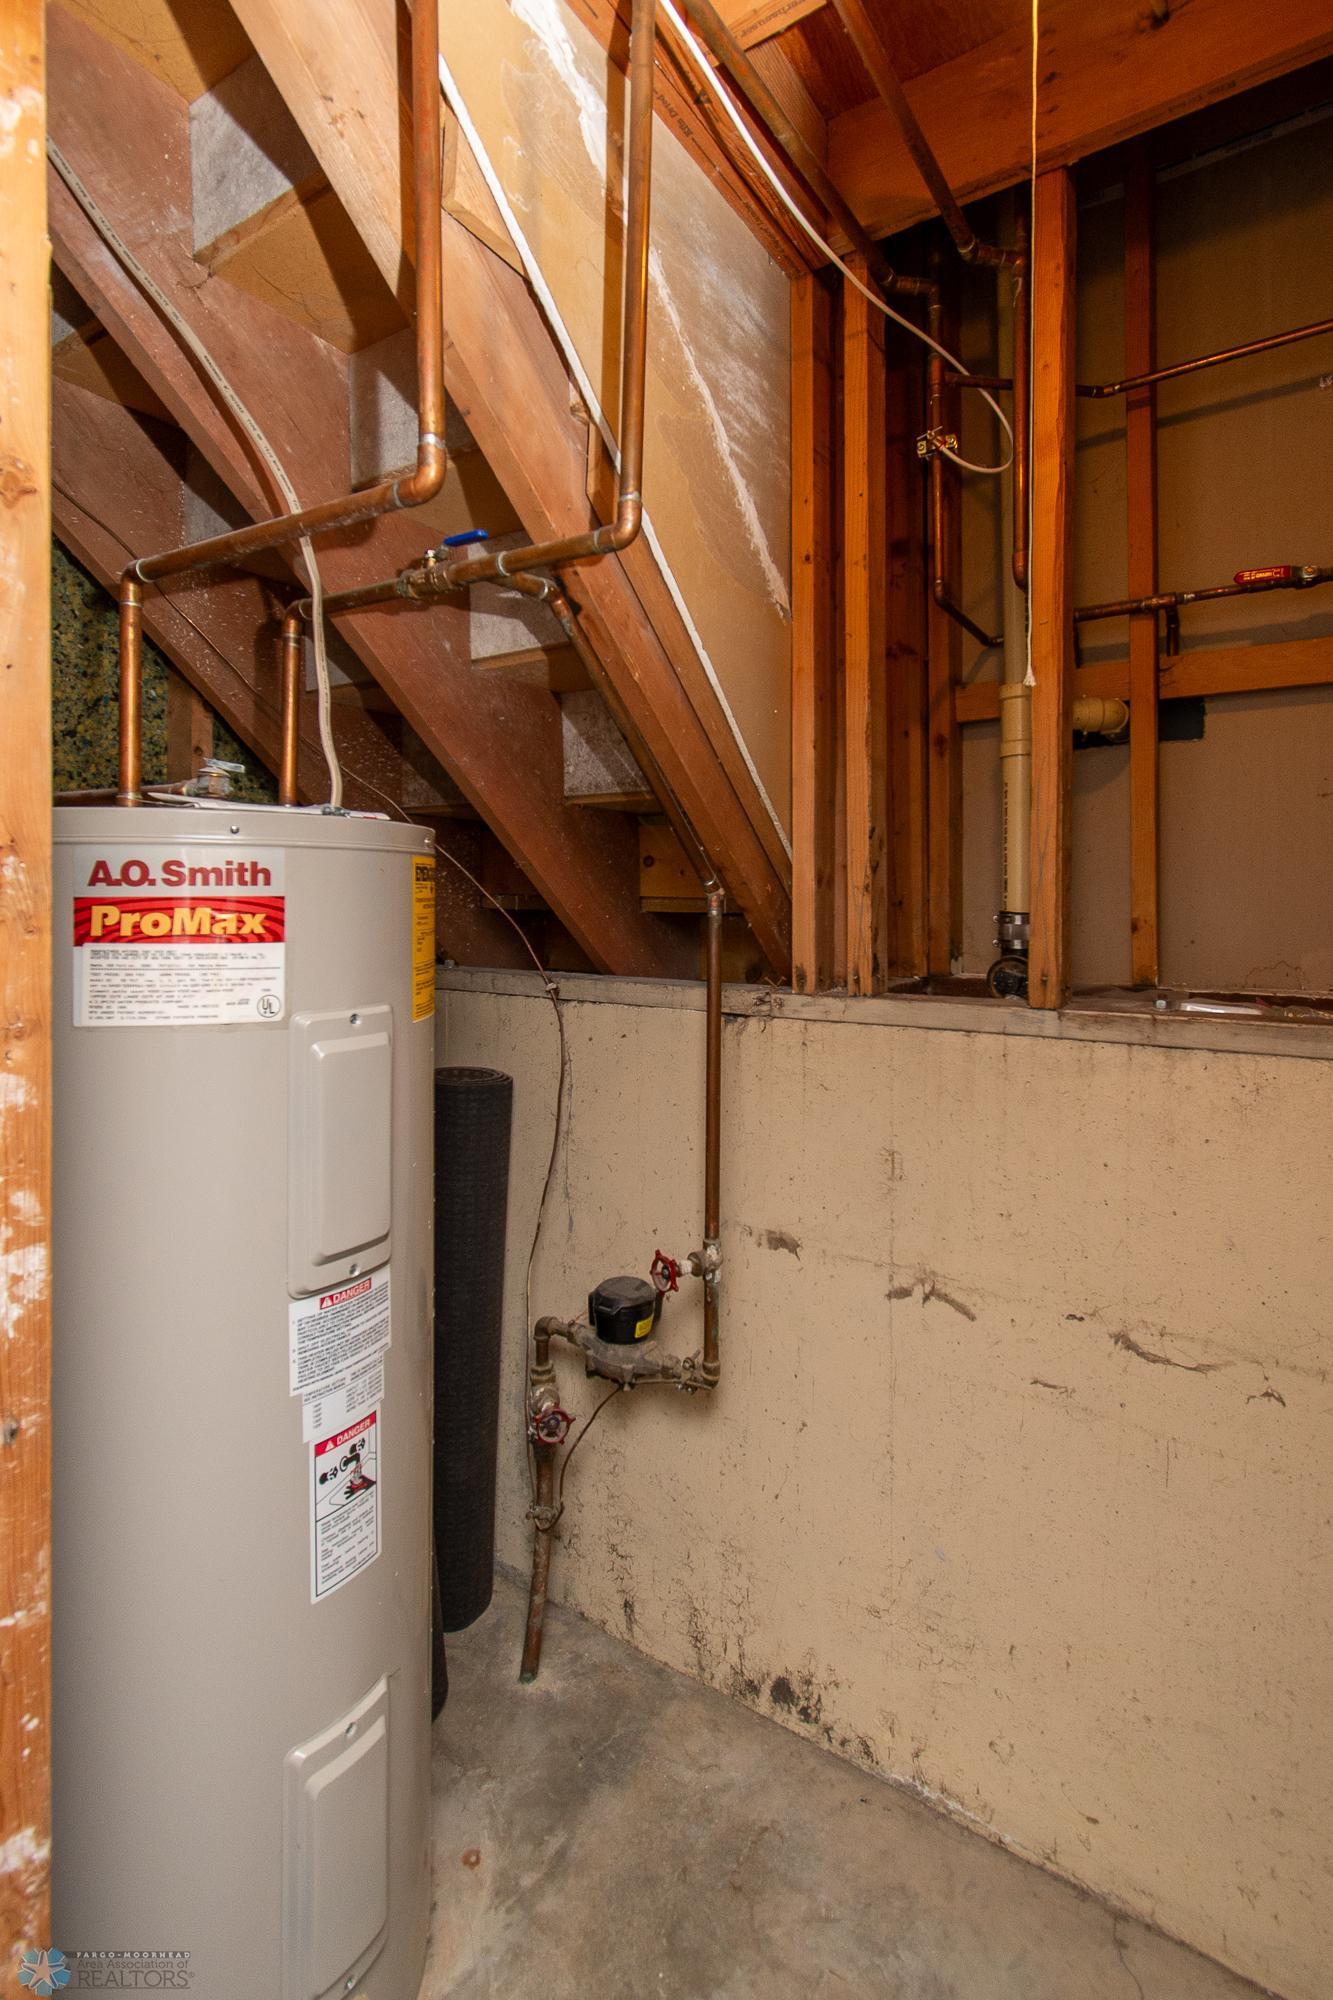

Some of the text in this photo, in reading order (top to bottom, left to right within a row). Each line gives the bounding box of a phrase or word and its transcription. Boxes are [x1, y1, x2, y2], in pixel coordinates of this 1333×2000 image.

[88, 860, 271, 887] A.O. Smith
[90, 905, 267, 937] ProMax
[333, 1279, 370, 1305] DANGER
[336, 1418, 370, 1446] DANGER
